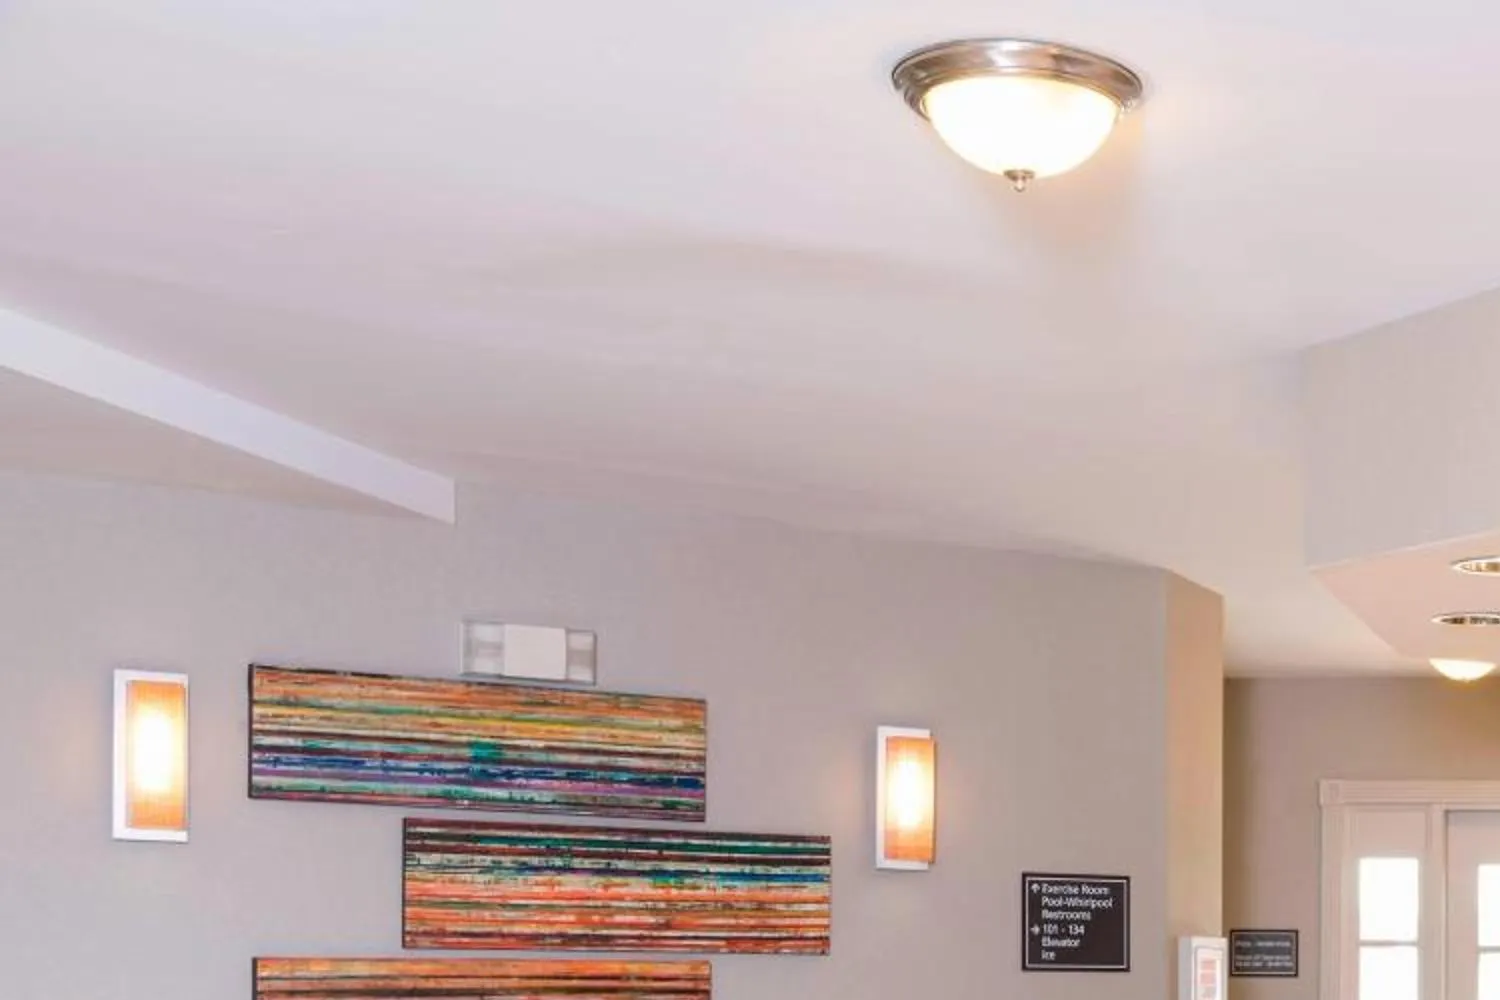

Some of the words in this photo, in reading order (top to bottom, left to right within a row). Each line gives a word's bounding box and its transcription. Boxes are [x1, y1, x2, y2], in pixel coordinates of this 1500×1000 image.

[1041, 883, 1080, 894] Exercise
[1081, 884, 1109, 895] Room
[1042, 909, 1091, 920] Restrooms
[1043, 923, 1058, 935] 101
[1068, 924, 1085, 936] 134
[1042, 936, 1080, 947] Elevator
[1042, 950, 1056, 960] Ice
